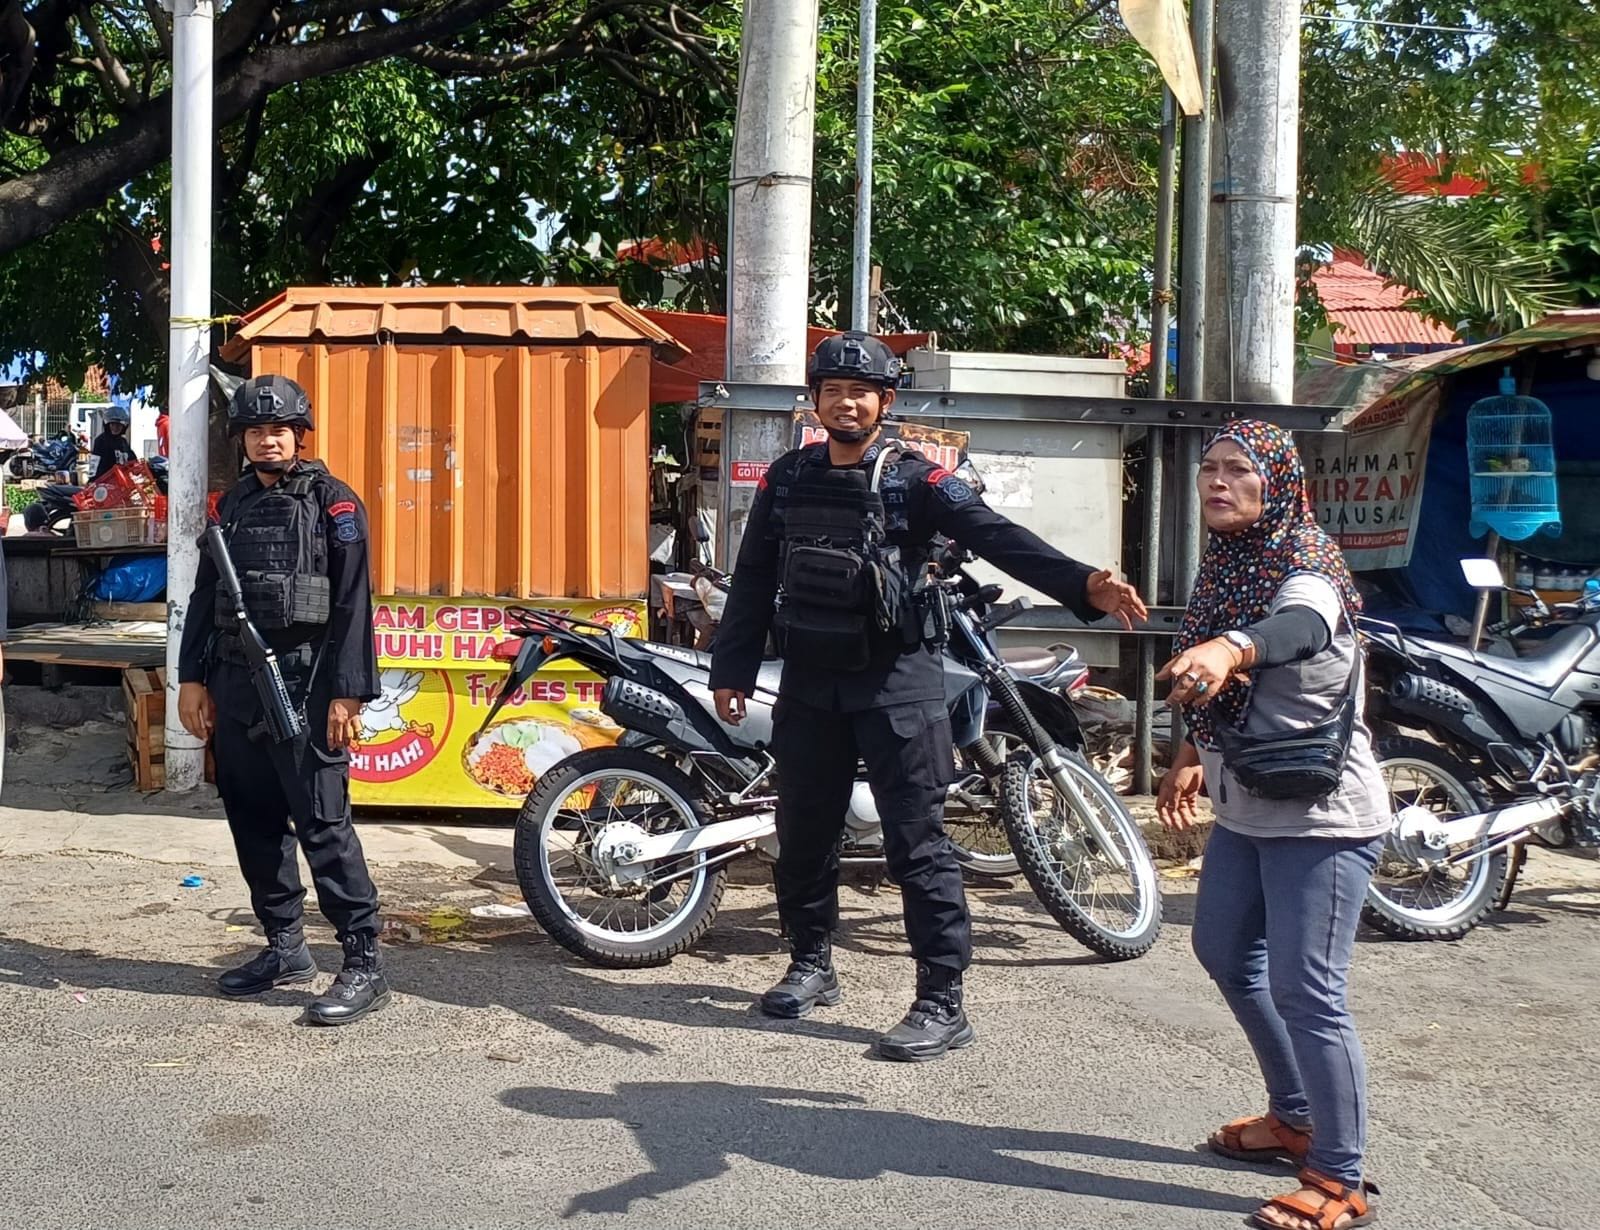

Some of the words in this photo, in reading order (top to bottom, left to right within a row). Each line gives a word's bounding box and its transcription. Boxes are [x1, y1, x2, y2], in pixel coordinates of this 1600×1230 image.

[1315, 452, 1415, 474] RAHMAT
[376, 634, 441, 658] UH!
[466, 673, 528, 706] Fre
[532, 682, 566, 702] ES
[375, 739, 424, 771] HAH!
